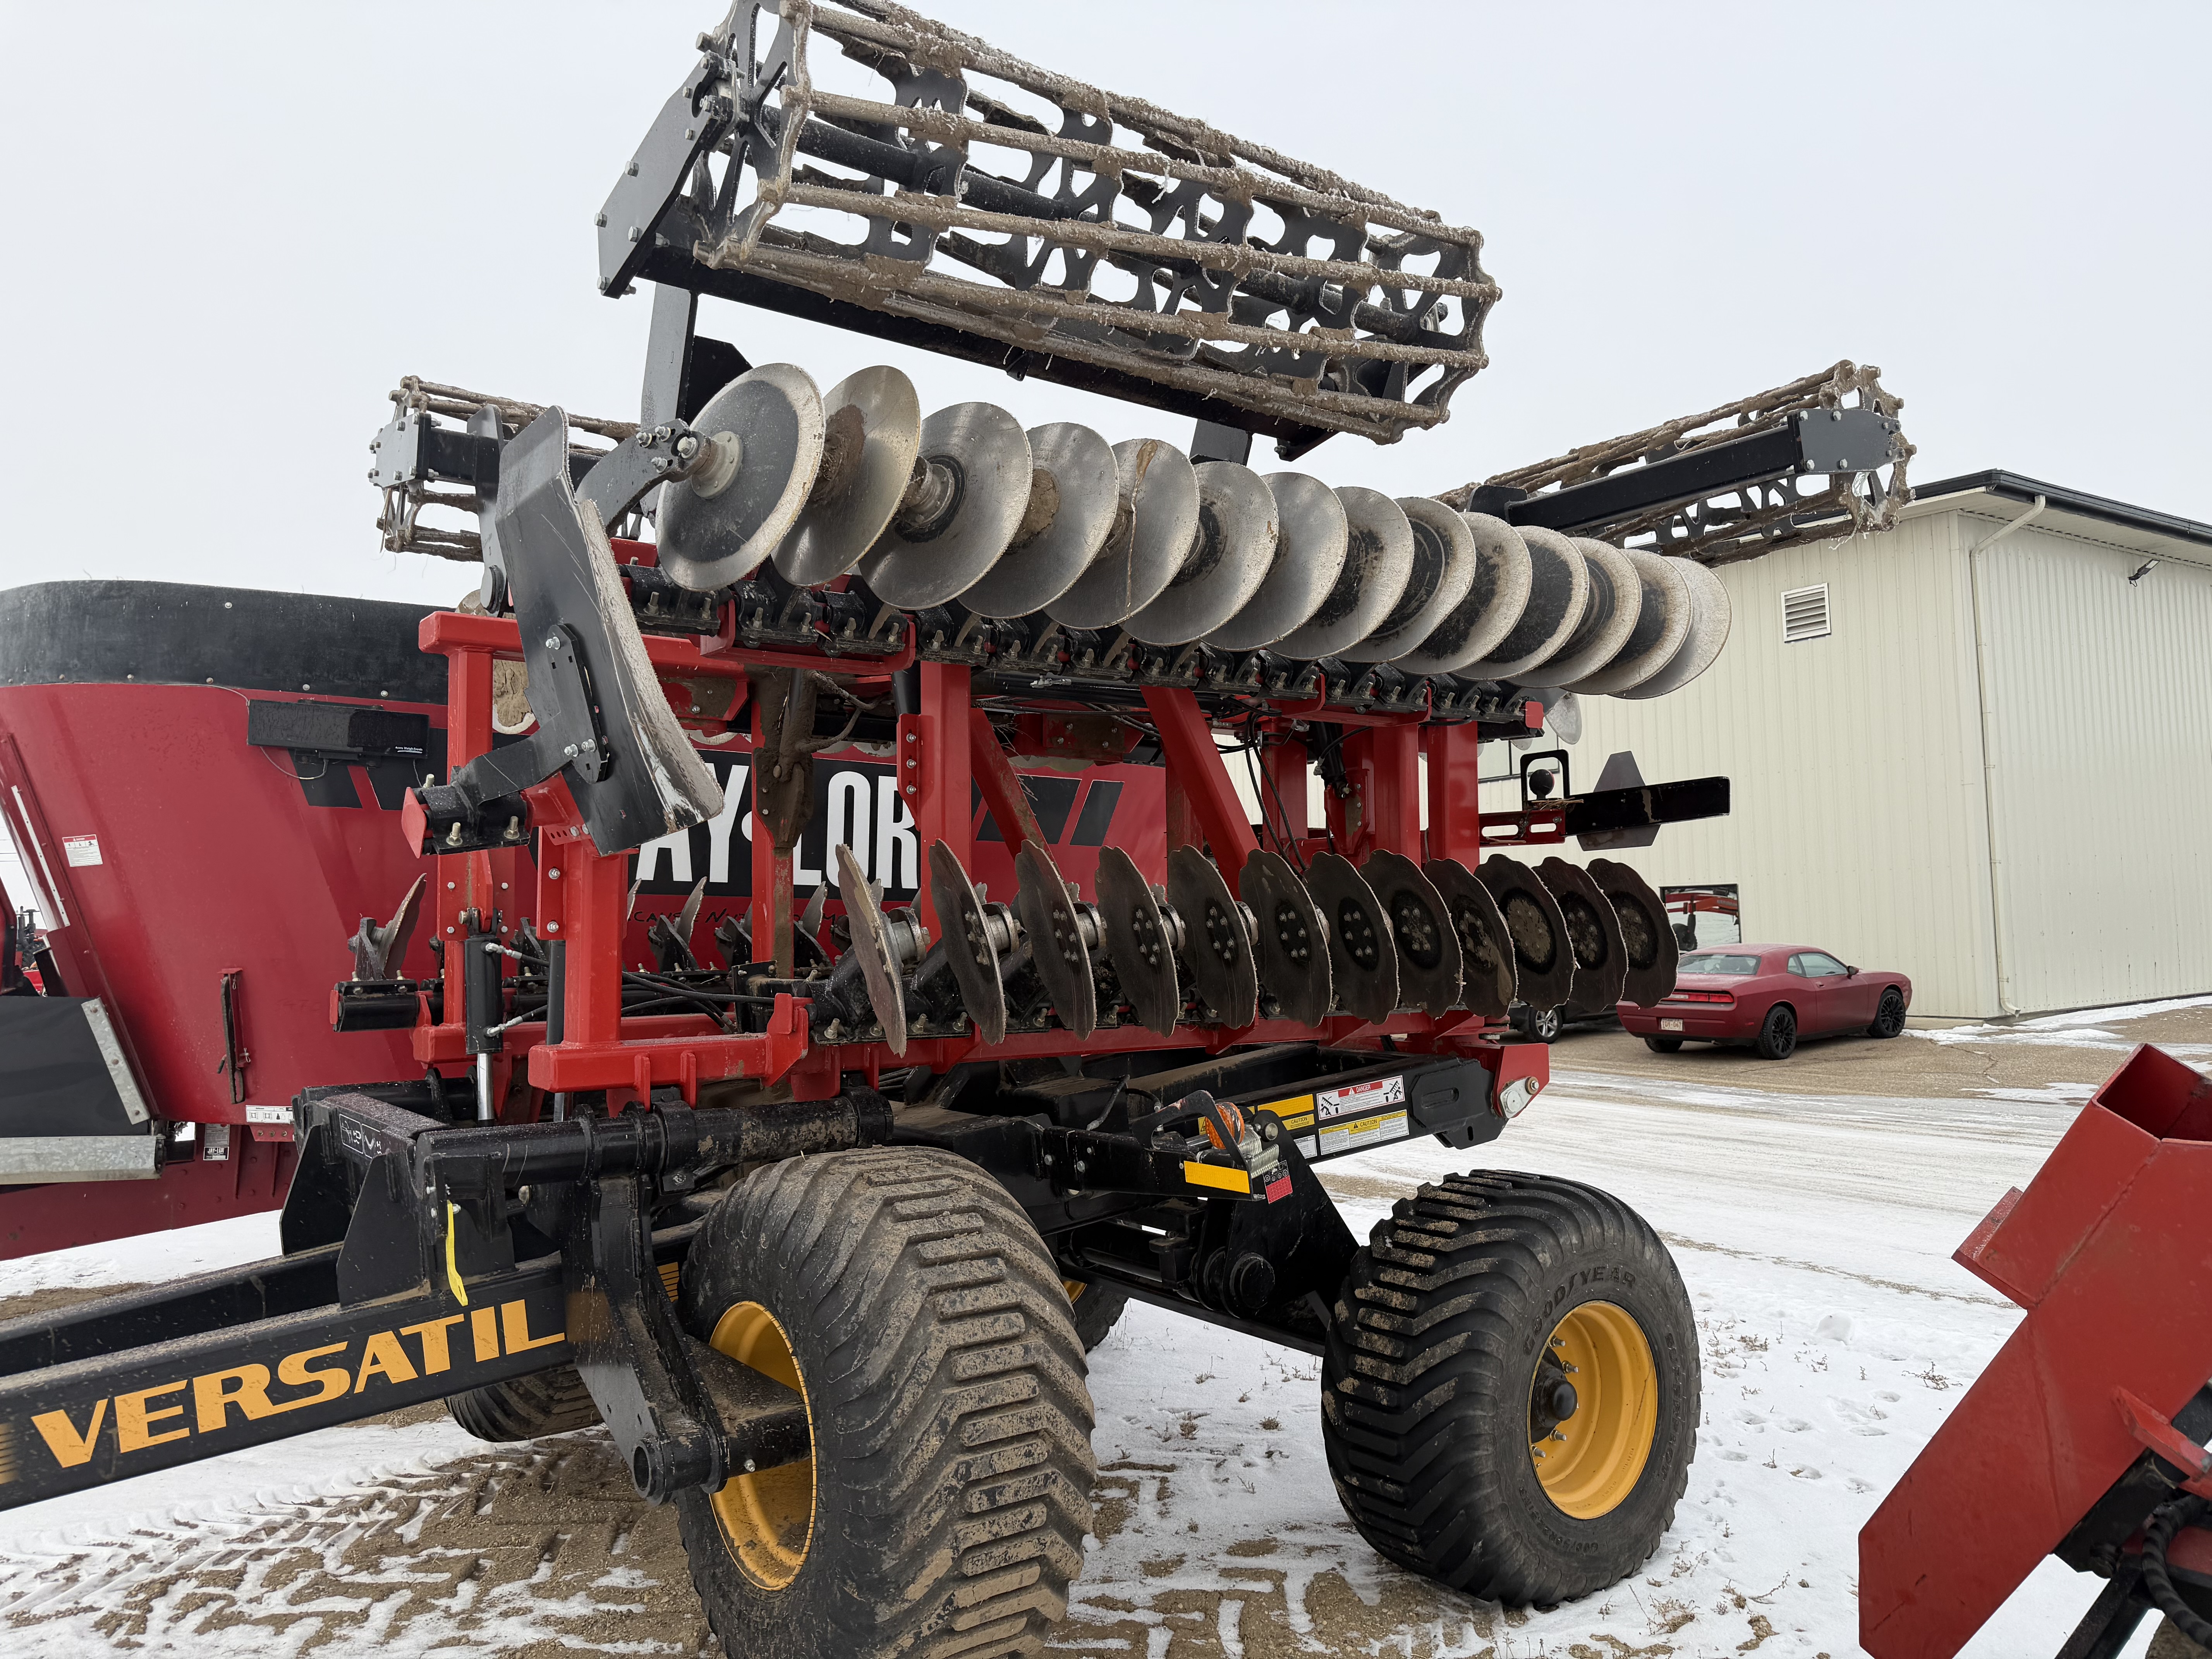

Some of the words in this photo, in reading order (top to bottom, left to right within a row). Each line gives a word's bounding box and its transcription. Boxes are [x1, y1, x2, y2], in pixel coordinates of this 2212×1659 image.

[1356, 1084, 1371, 1093] DANGER
[1360, 1118, 1377, 1127] CAUTION
[1523, 1266, 1636, 1356] GOODYEAR
